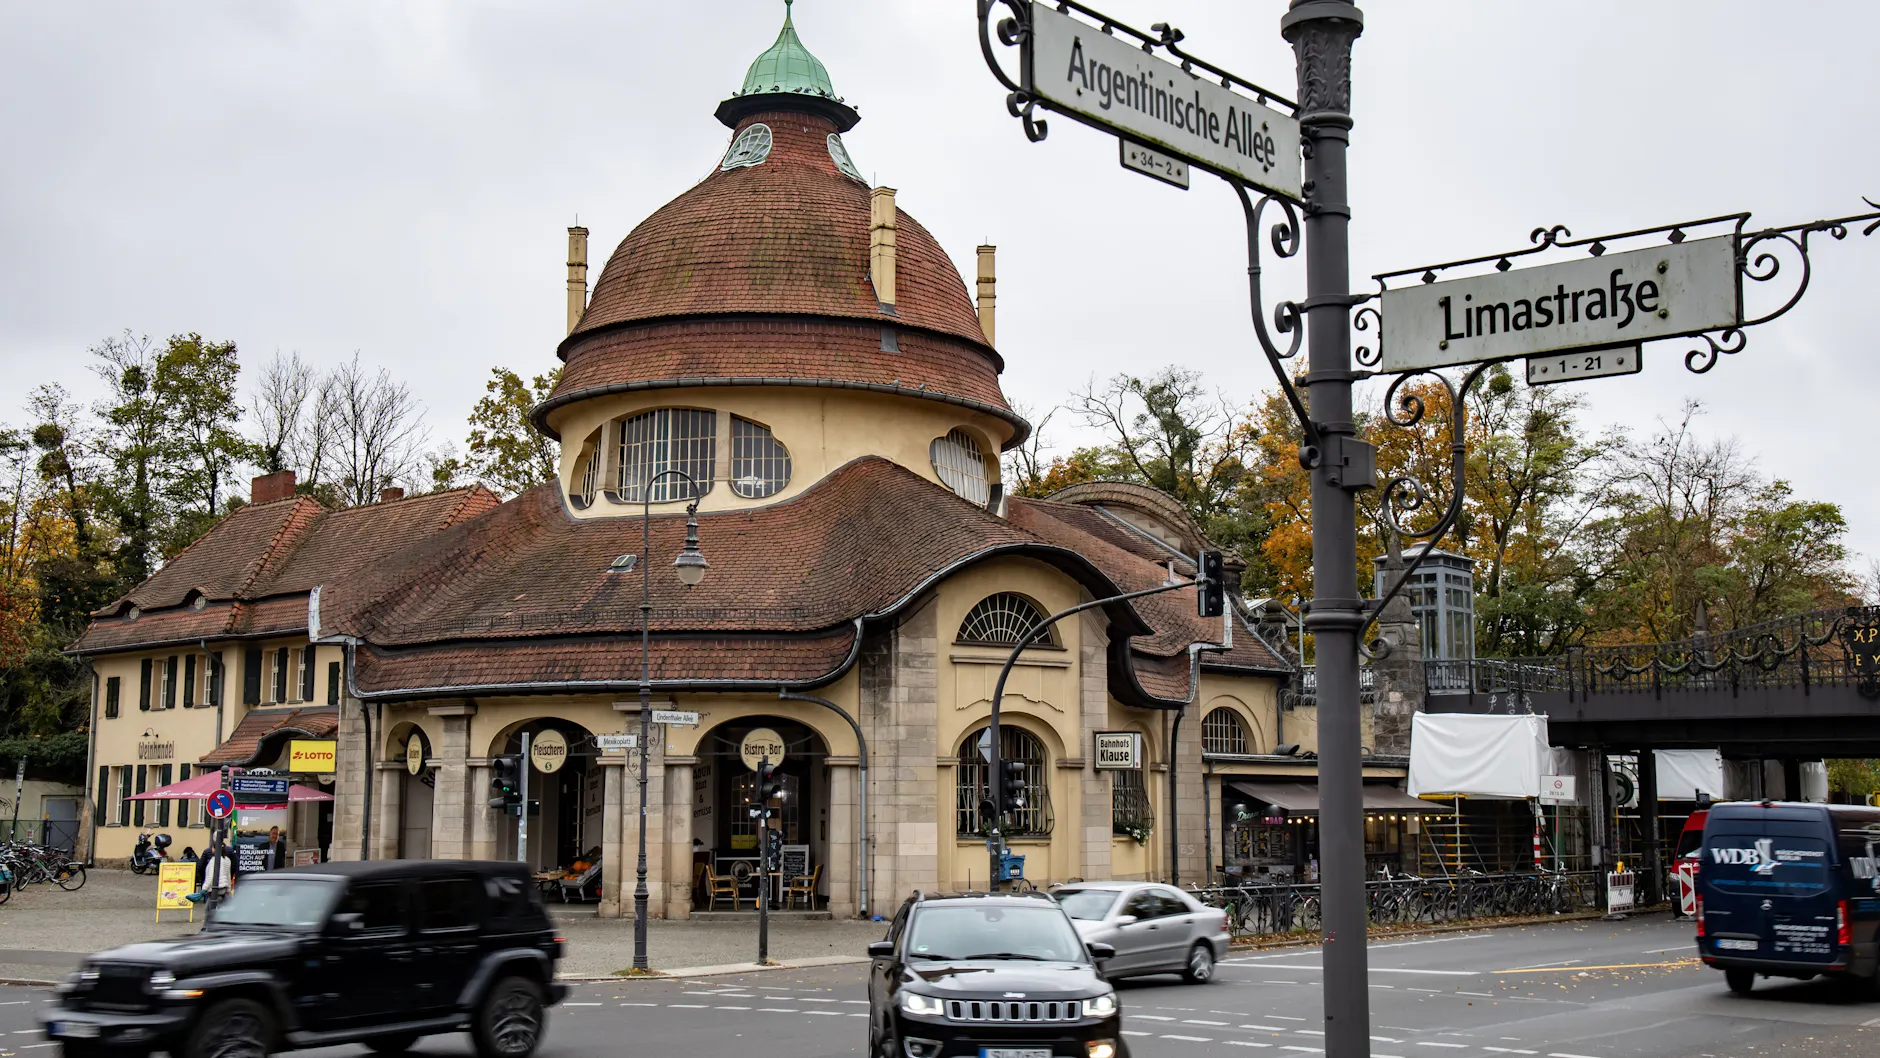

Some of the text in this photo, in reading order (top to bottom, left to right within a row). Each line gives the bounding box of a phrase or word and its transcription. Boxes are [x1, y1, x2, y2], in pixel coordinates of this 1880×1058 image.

[1067, 36, 1275, 168] Argentinische Allee
[1441, 268, 1659, 340] Limastraße
[656, 712, 694, 722] Lindenthaler Allee
[603, 737, 631, 746] Mexikoplatz
[1100, 739, 1130, 748] Bahnhofs
[139, 740, 175, 759] Weinhandel
[534, 744, 565, 756] Fleischerei
[1100, 749, 1130, 762] Klause
[305, 752, 333, 760] LOTTO
[1711, 848, 1759, 864] WDB
